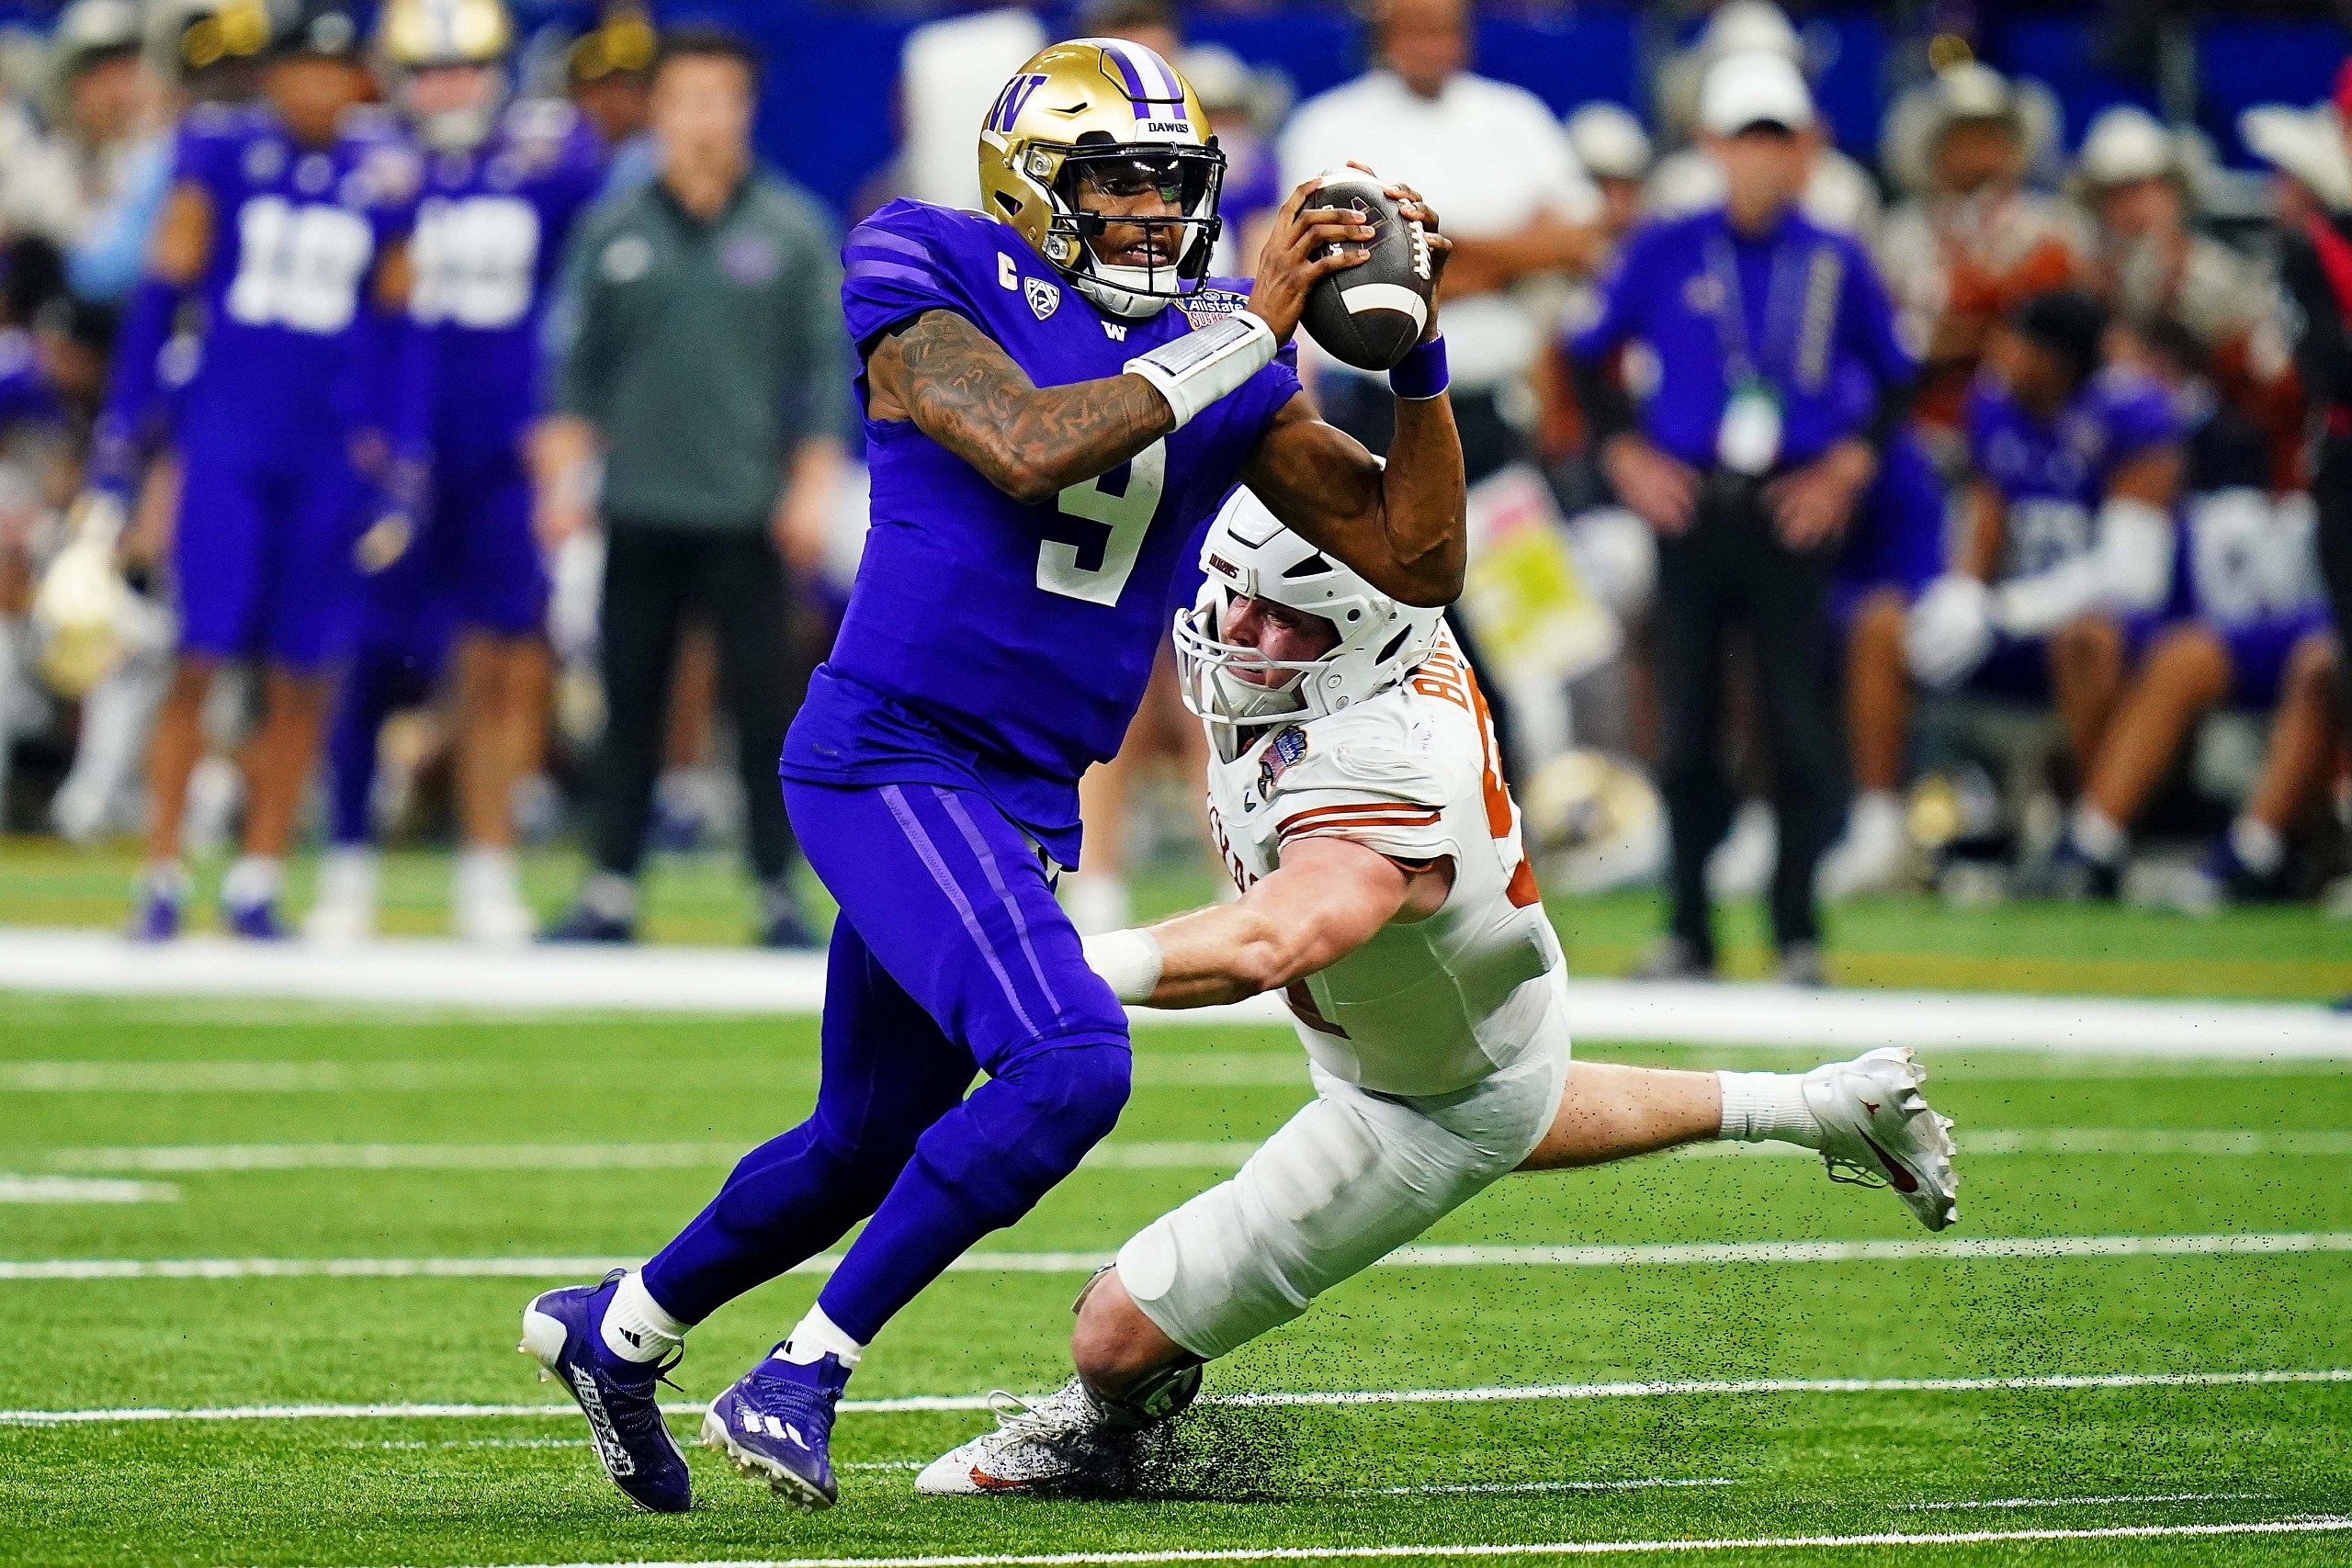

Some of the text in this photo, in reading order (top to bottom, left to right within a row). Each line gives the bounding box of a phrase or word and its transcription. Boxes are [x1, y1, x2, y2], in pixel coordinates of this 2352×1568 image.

[1148, 121, 1189, 134] DAWGS
[997, 251, 1018, 291] C
[1033, 295, 1051, 313] 12
[1189, 299, 1244, 312] Allstate
[1101, 320, 1127, 343] W
[1036, 435, 1167, 608] 9
